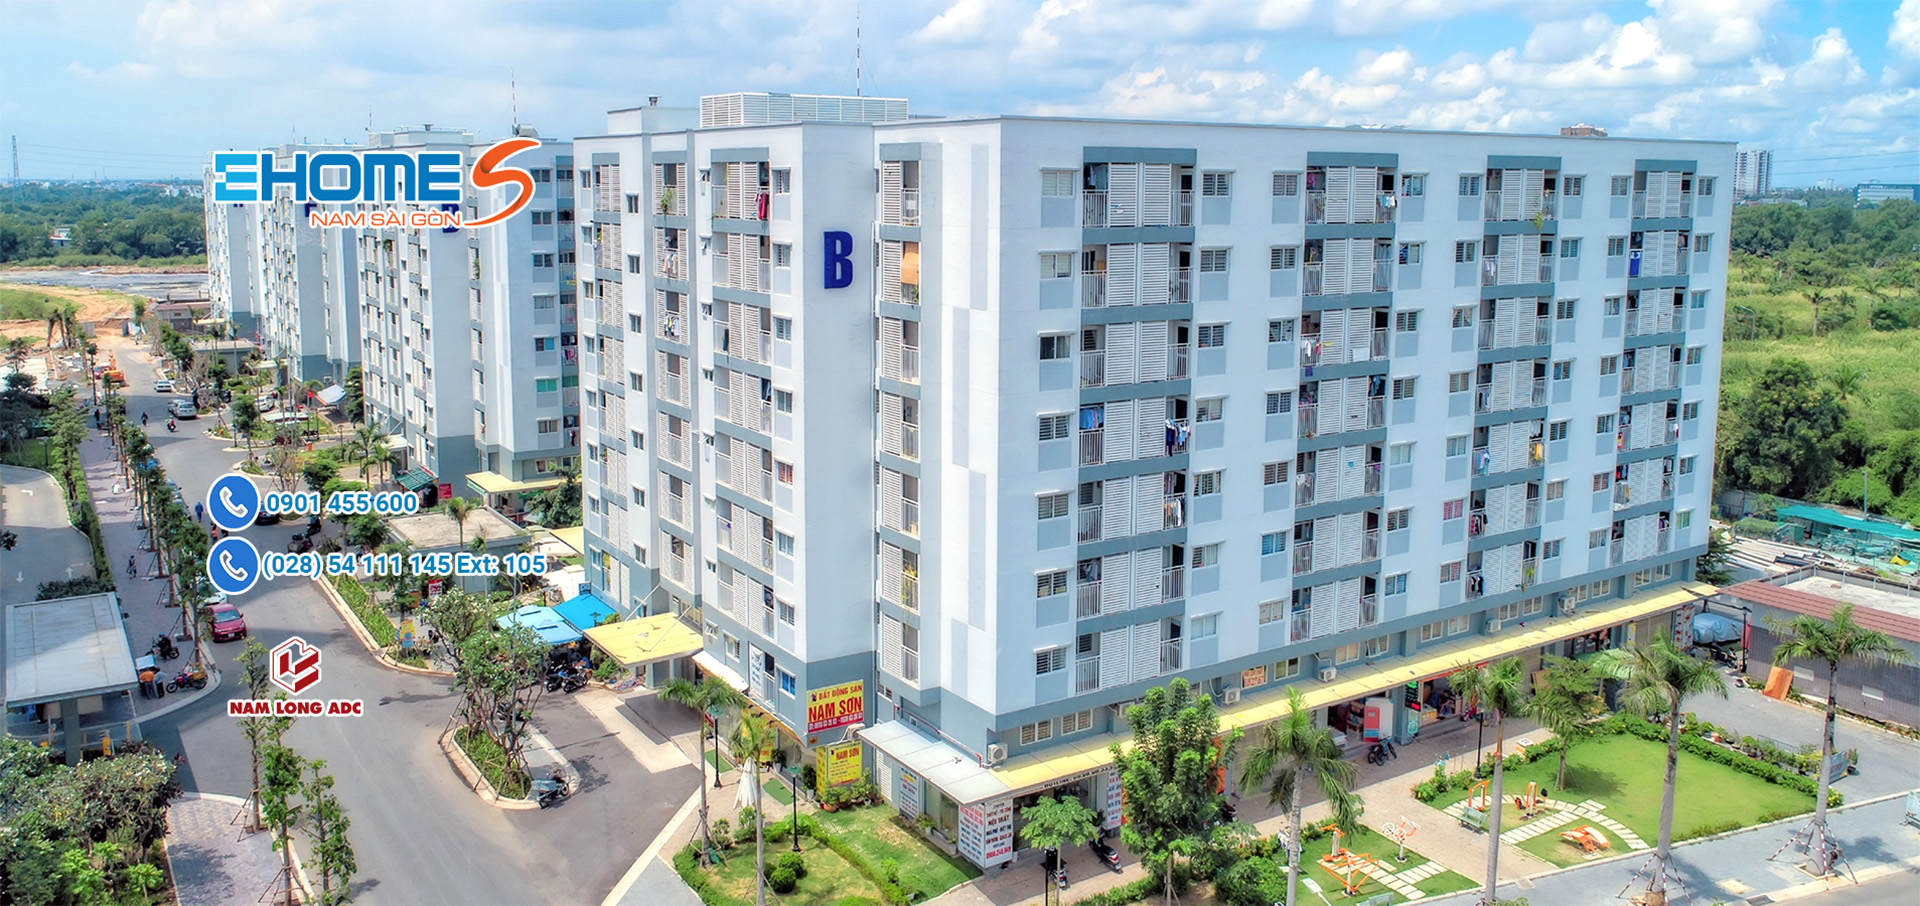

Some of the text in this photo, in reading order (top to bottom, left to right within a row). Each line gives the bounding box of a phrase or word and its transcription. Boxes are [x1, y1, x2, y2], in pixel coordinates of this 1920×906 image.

[824, 231, 853, 289] B
[808, 702, 836, 722] NAM
[839, 696, 862, 715] SƠN
